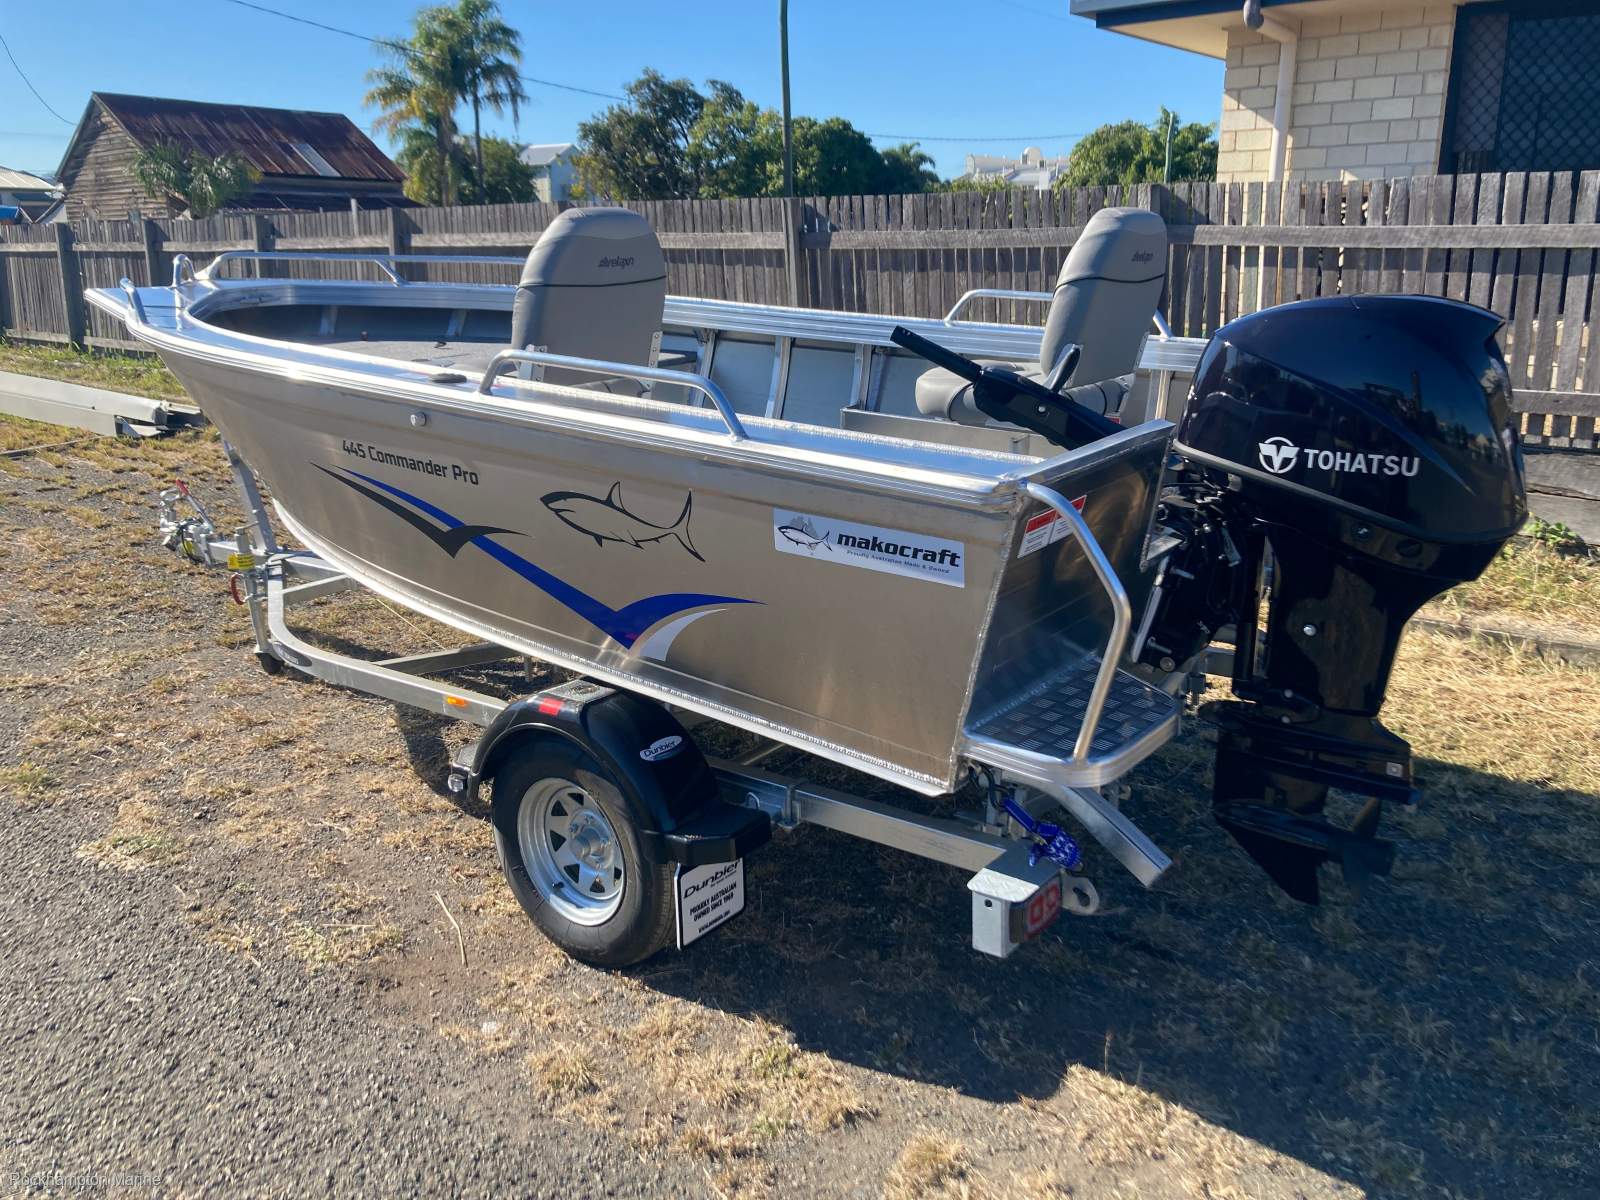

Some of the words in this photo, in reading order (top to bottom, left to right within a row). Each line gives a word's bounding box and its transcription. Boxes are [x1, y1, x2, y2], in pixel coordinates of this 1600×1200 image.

[342, 439, 366, 459] 445
[367, 445, 448, 478] Commander
[451, 464, 479, 486] Pro
[1303, 448, 1420, 477] TOHATSU
[836, 532, 961, 568] makocraft
[684, 861, 738, 900] Dunbier
